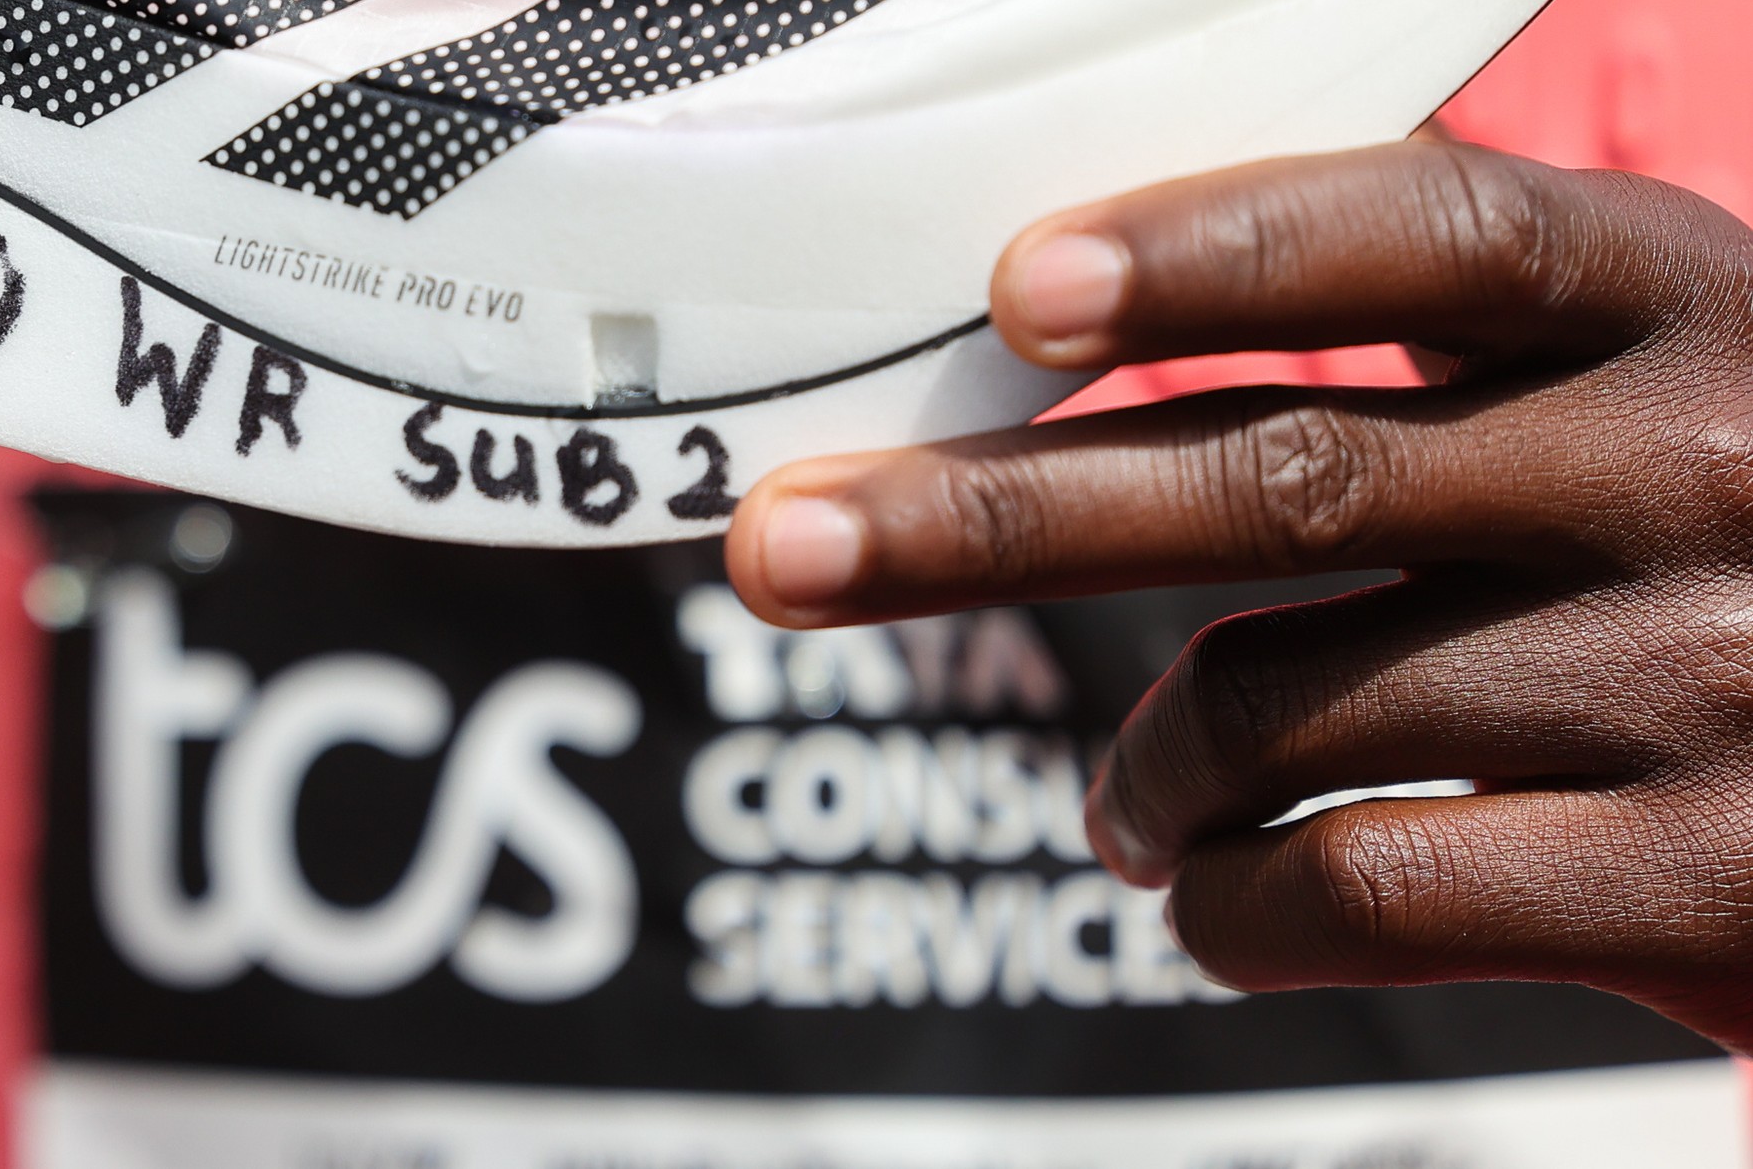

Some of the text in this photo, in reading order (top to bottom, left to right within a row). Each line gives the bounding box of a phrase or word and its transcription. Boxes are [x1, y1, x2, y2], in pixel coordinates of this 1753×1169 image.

[214, 234, 525, 323] LIGHTSTRIKE PRO EVO
[115, 275, 308, 457] WR
[667, 426, 740, 520] 2
